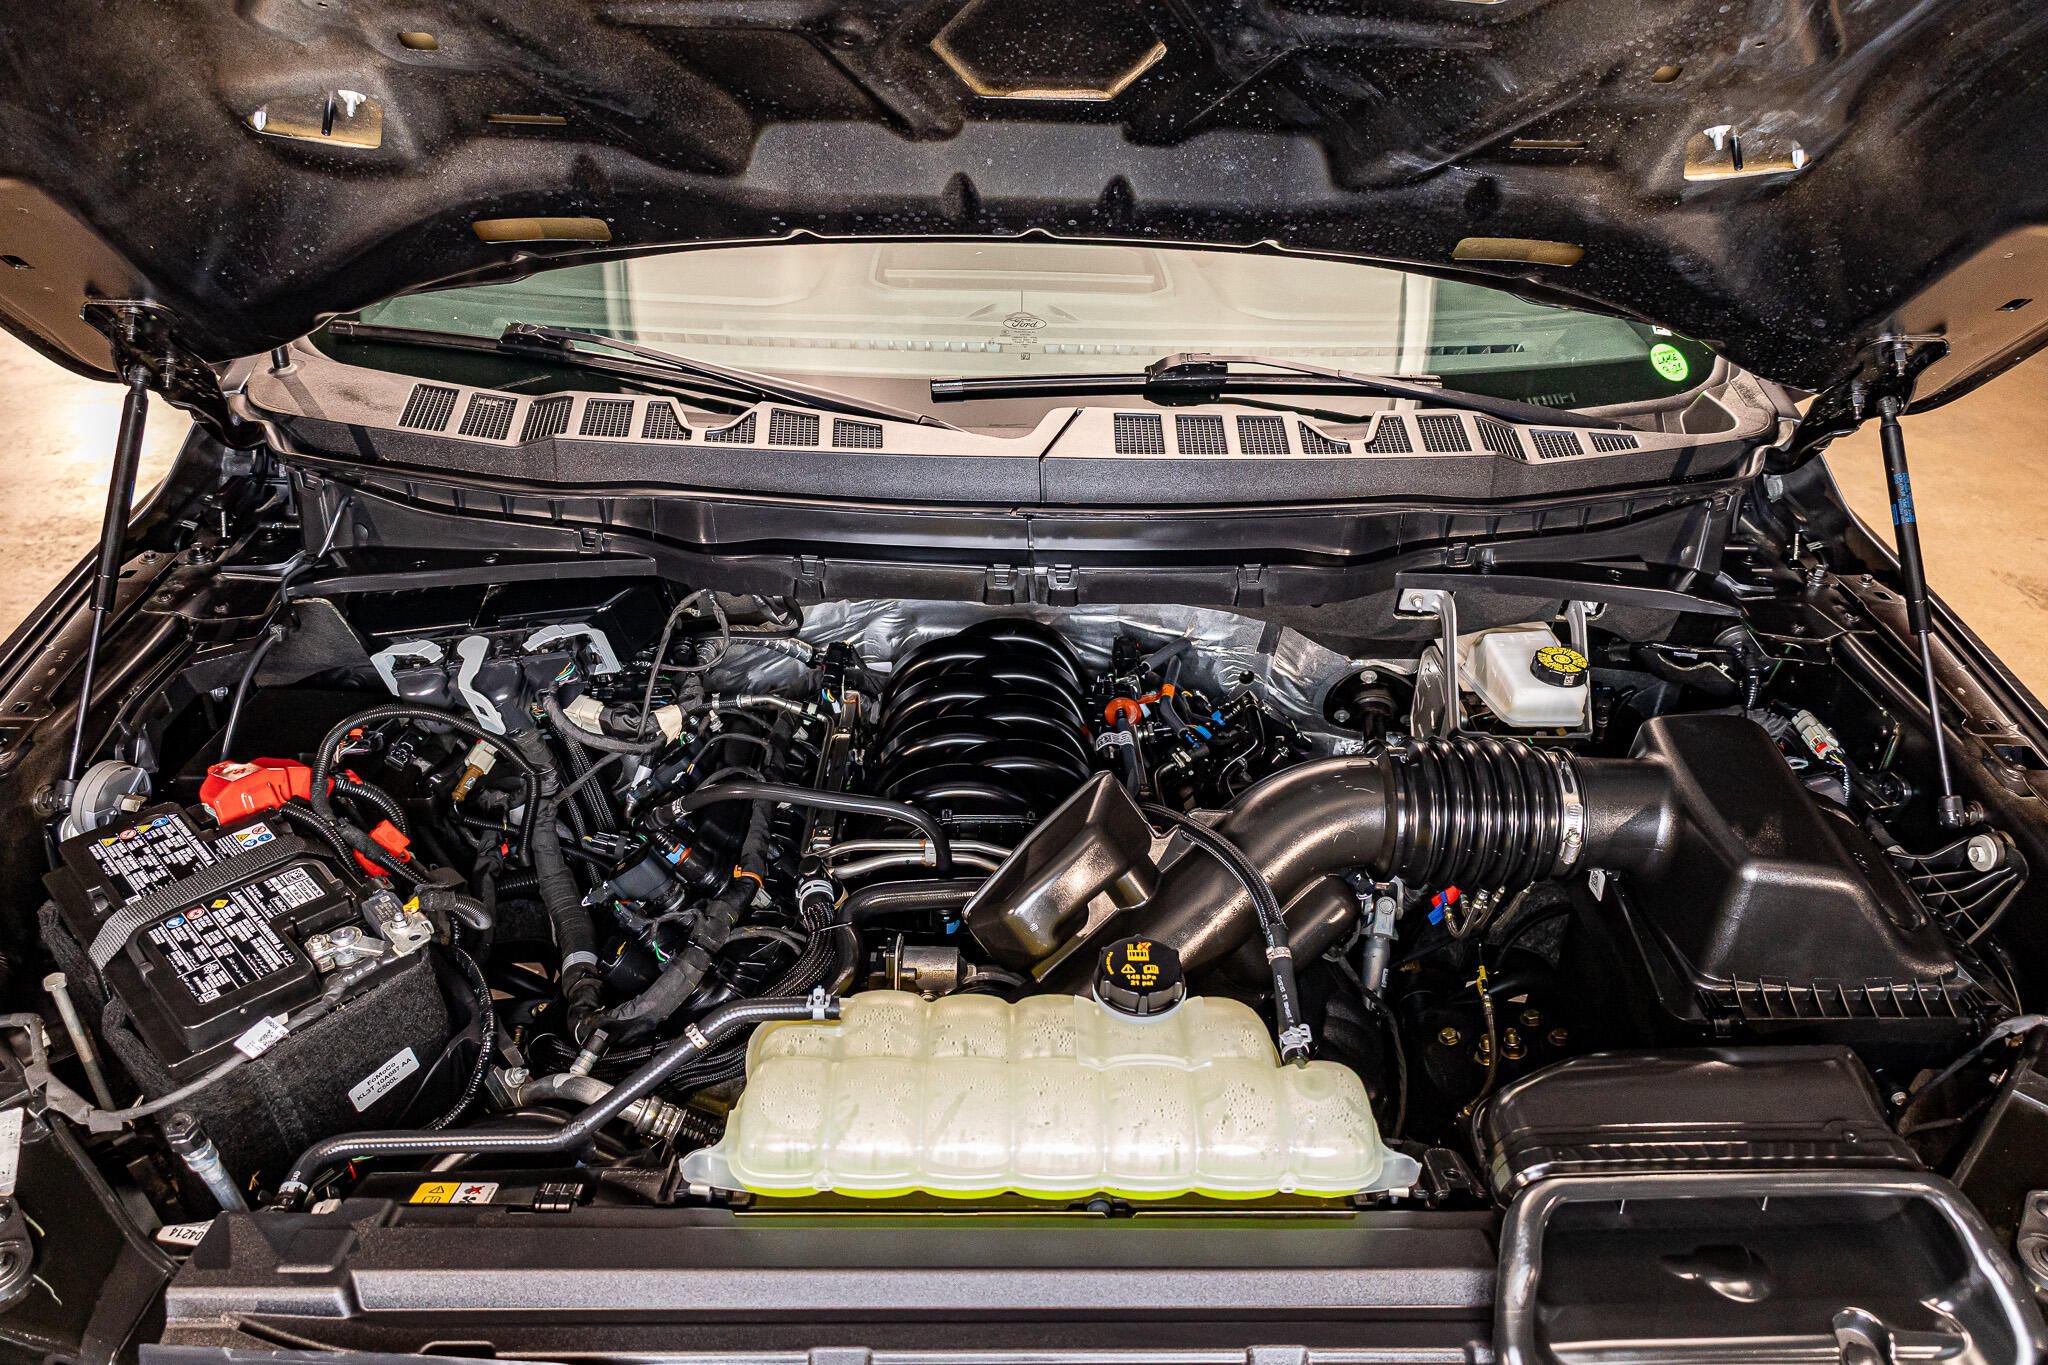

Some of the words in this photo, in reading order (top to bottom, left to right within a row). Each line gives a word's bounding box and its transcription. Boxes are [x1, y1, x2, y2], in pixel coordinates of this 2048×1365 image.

[1010, 317, 1038, 328] Ford
[402, 1058, 412, 1067] AA
[367, 1062, 396, 1085] FoMoCo
